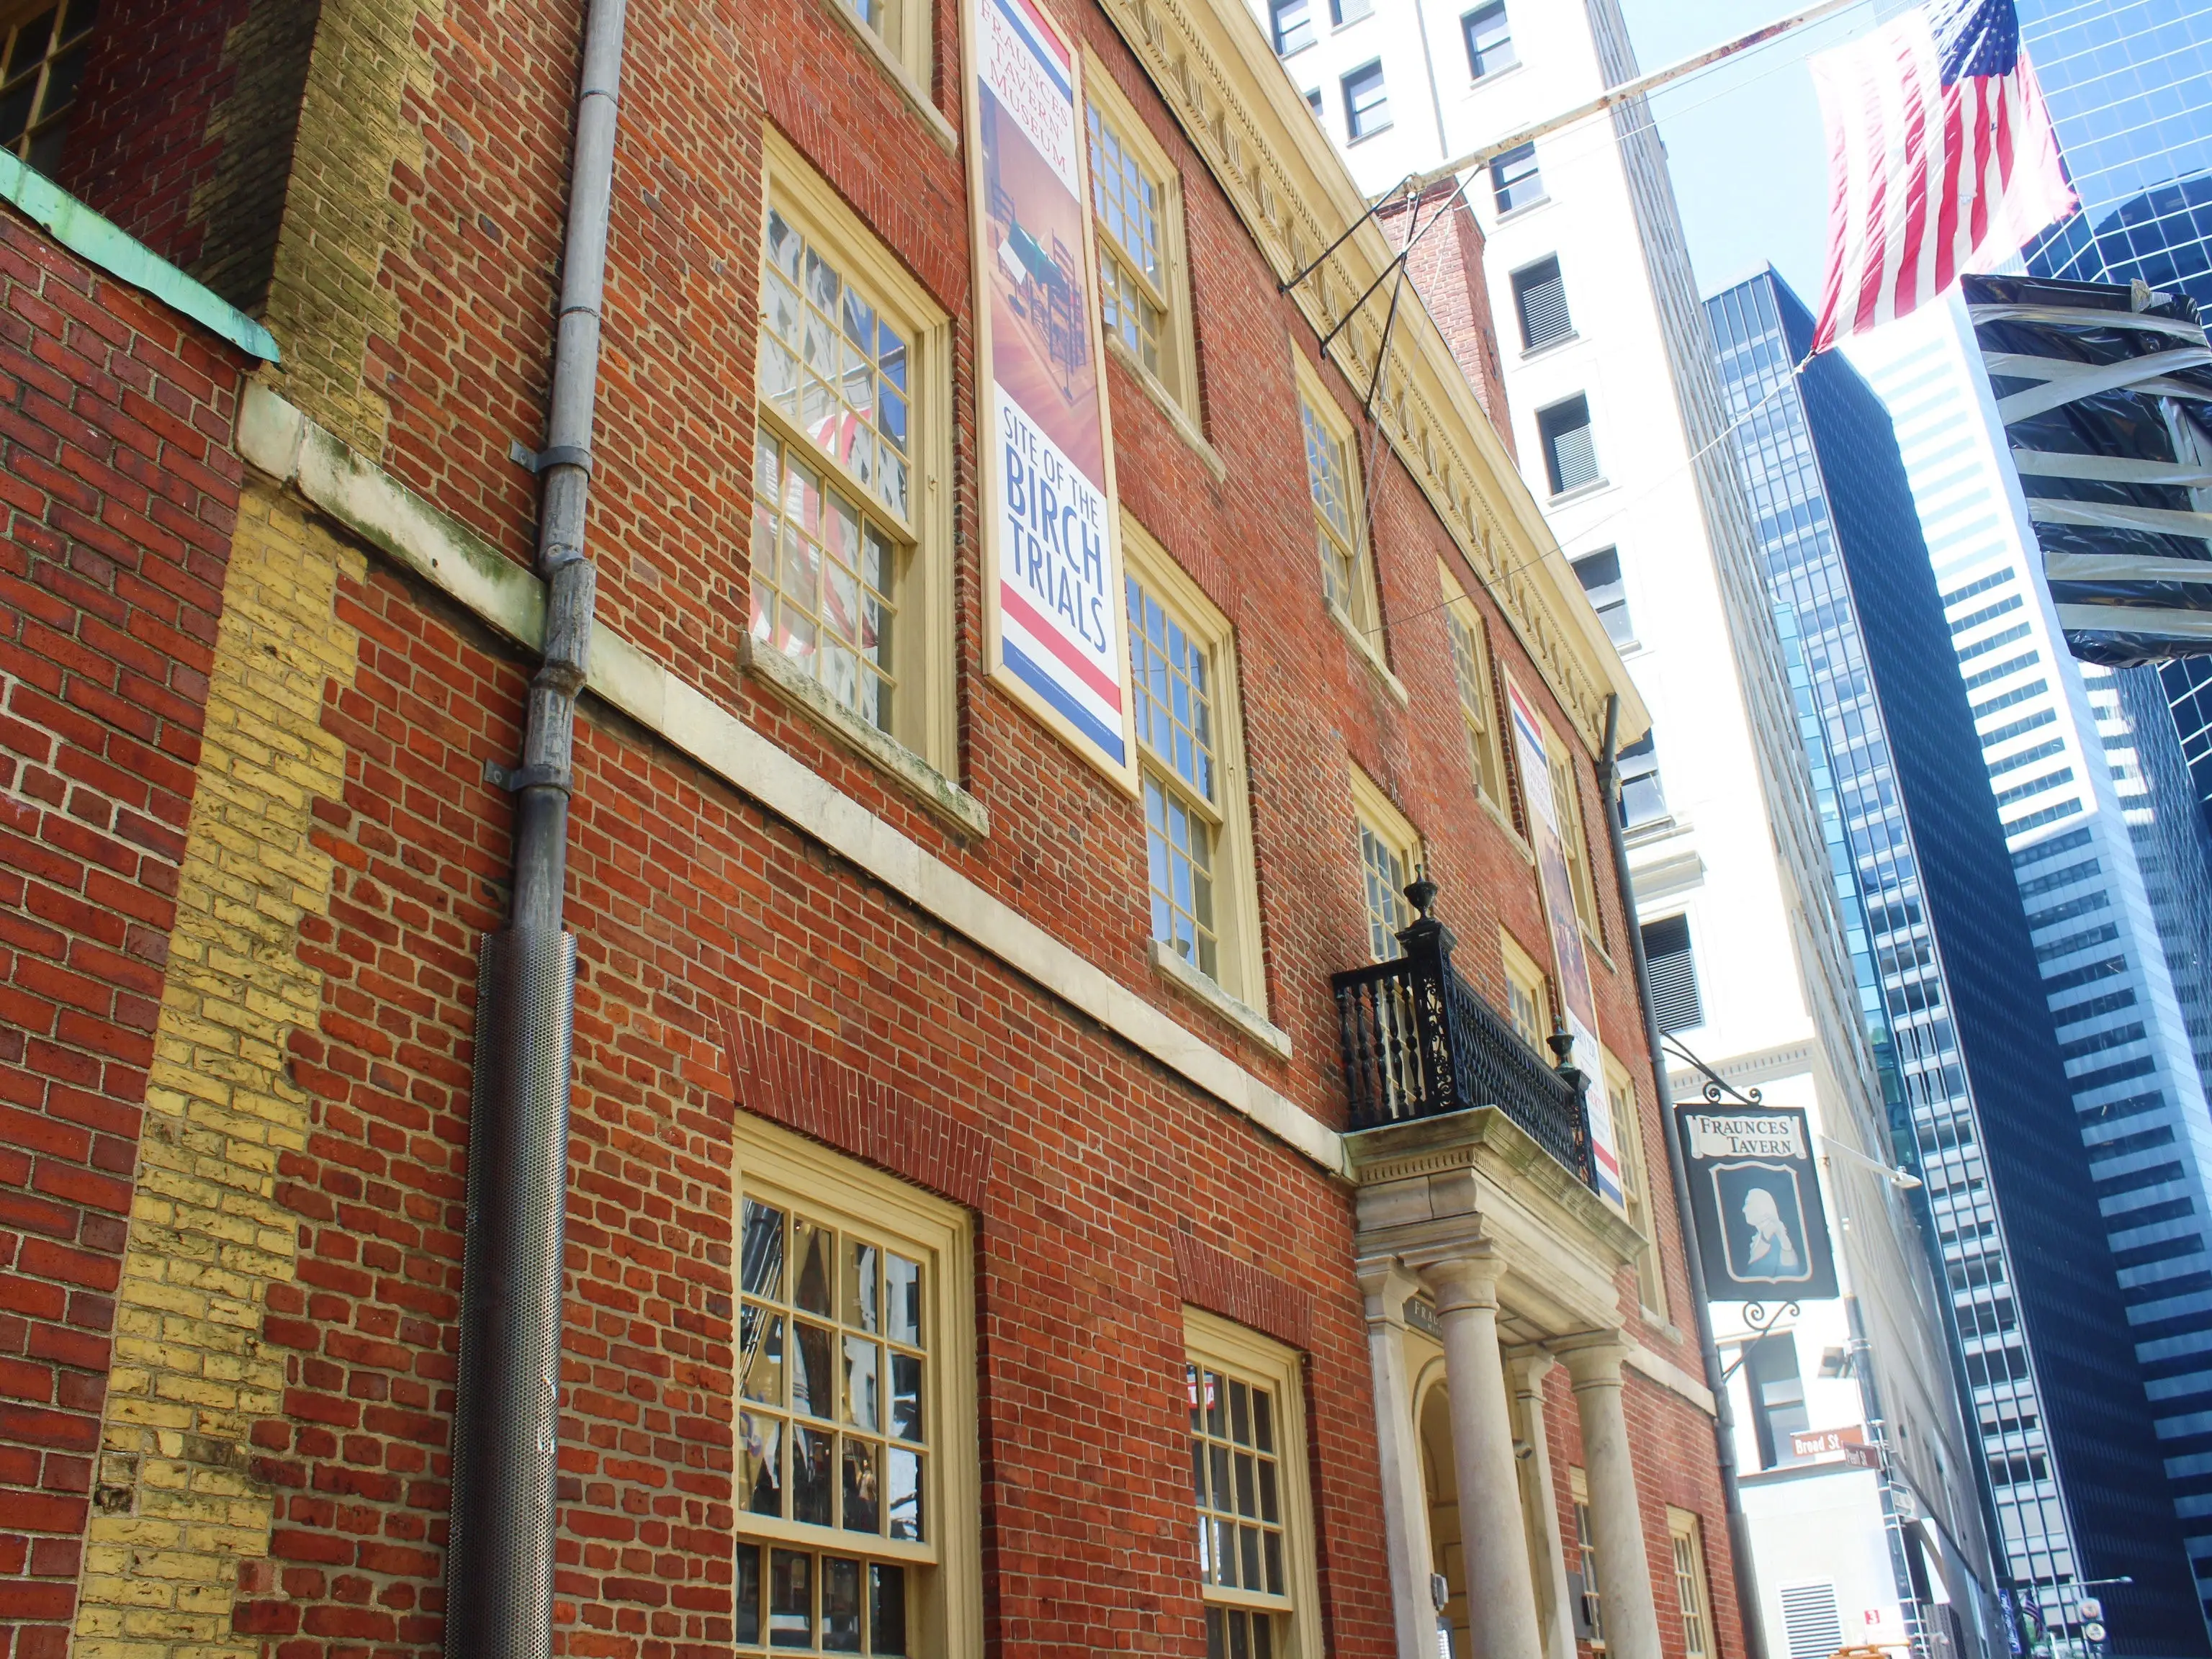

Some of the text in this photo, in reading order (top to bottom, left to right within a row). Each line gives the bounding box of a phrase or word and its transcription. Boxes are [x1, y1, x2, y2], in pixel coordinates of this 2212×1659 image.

[980, 0, 1068, 127] FRAUNCES
[989, 58, 1067, 174] MUSEUM
[992, 35, 1060, 142] TAVERN
[1003, 406, 1099, 530] SITE OF THE
[1005, 441, 1103, 597] BIRCH
[1007, 513, 1107, 655] TRIALS
[1700, 1117, 1789, 1136] FRAUNCES
[1726, 1136, 1793, 1154] TAVERN
[1795, 1434, 1840, 1455] Broad St
